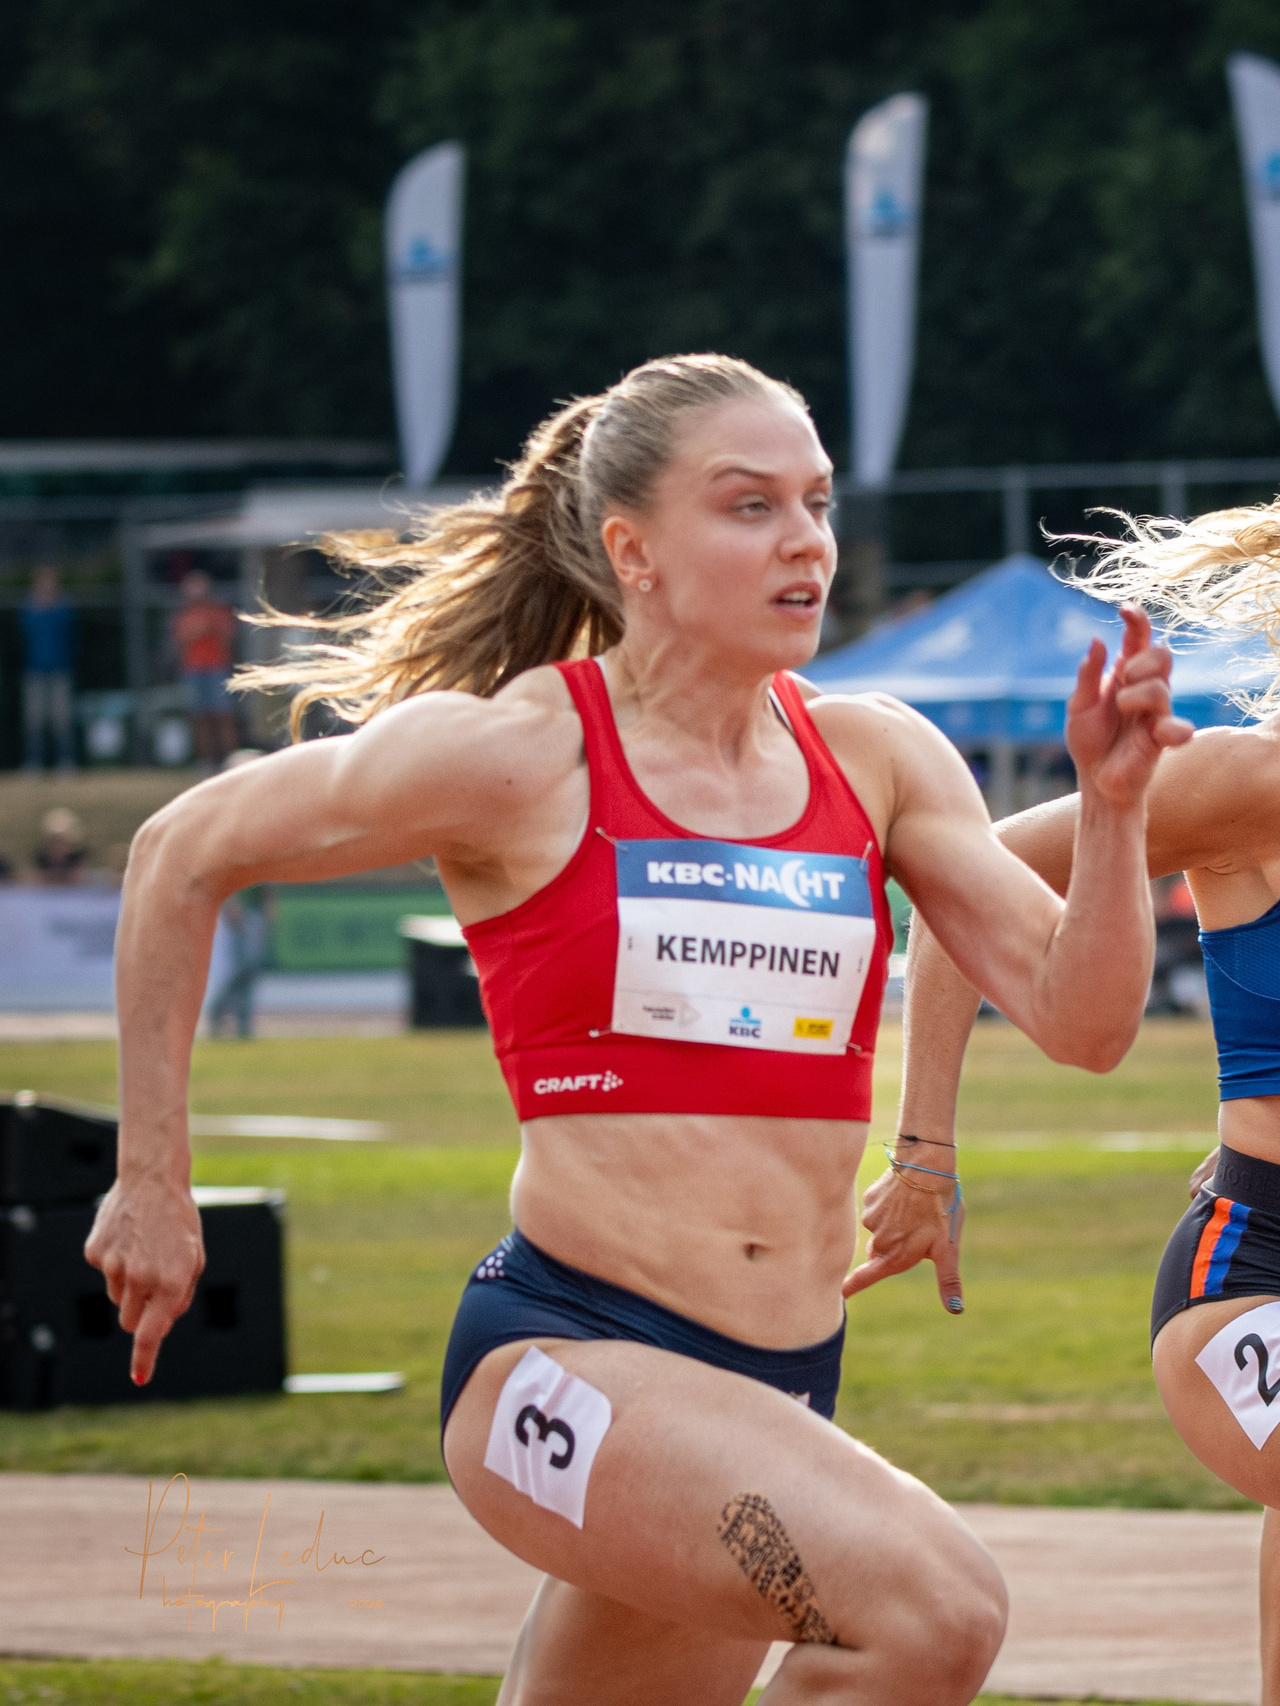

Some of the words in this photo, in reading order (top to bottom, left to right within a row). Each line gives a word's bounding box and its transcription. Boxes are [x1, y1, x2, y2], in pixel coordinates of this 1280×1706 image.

[657, 934, 840, 978] KEMPPINEN
[729, 1025, 761, 1038] KBC
[533, 1073, 602, 1095] CRAFT
[515, 1404, 576, 1470] 3
